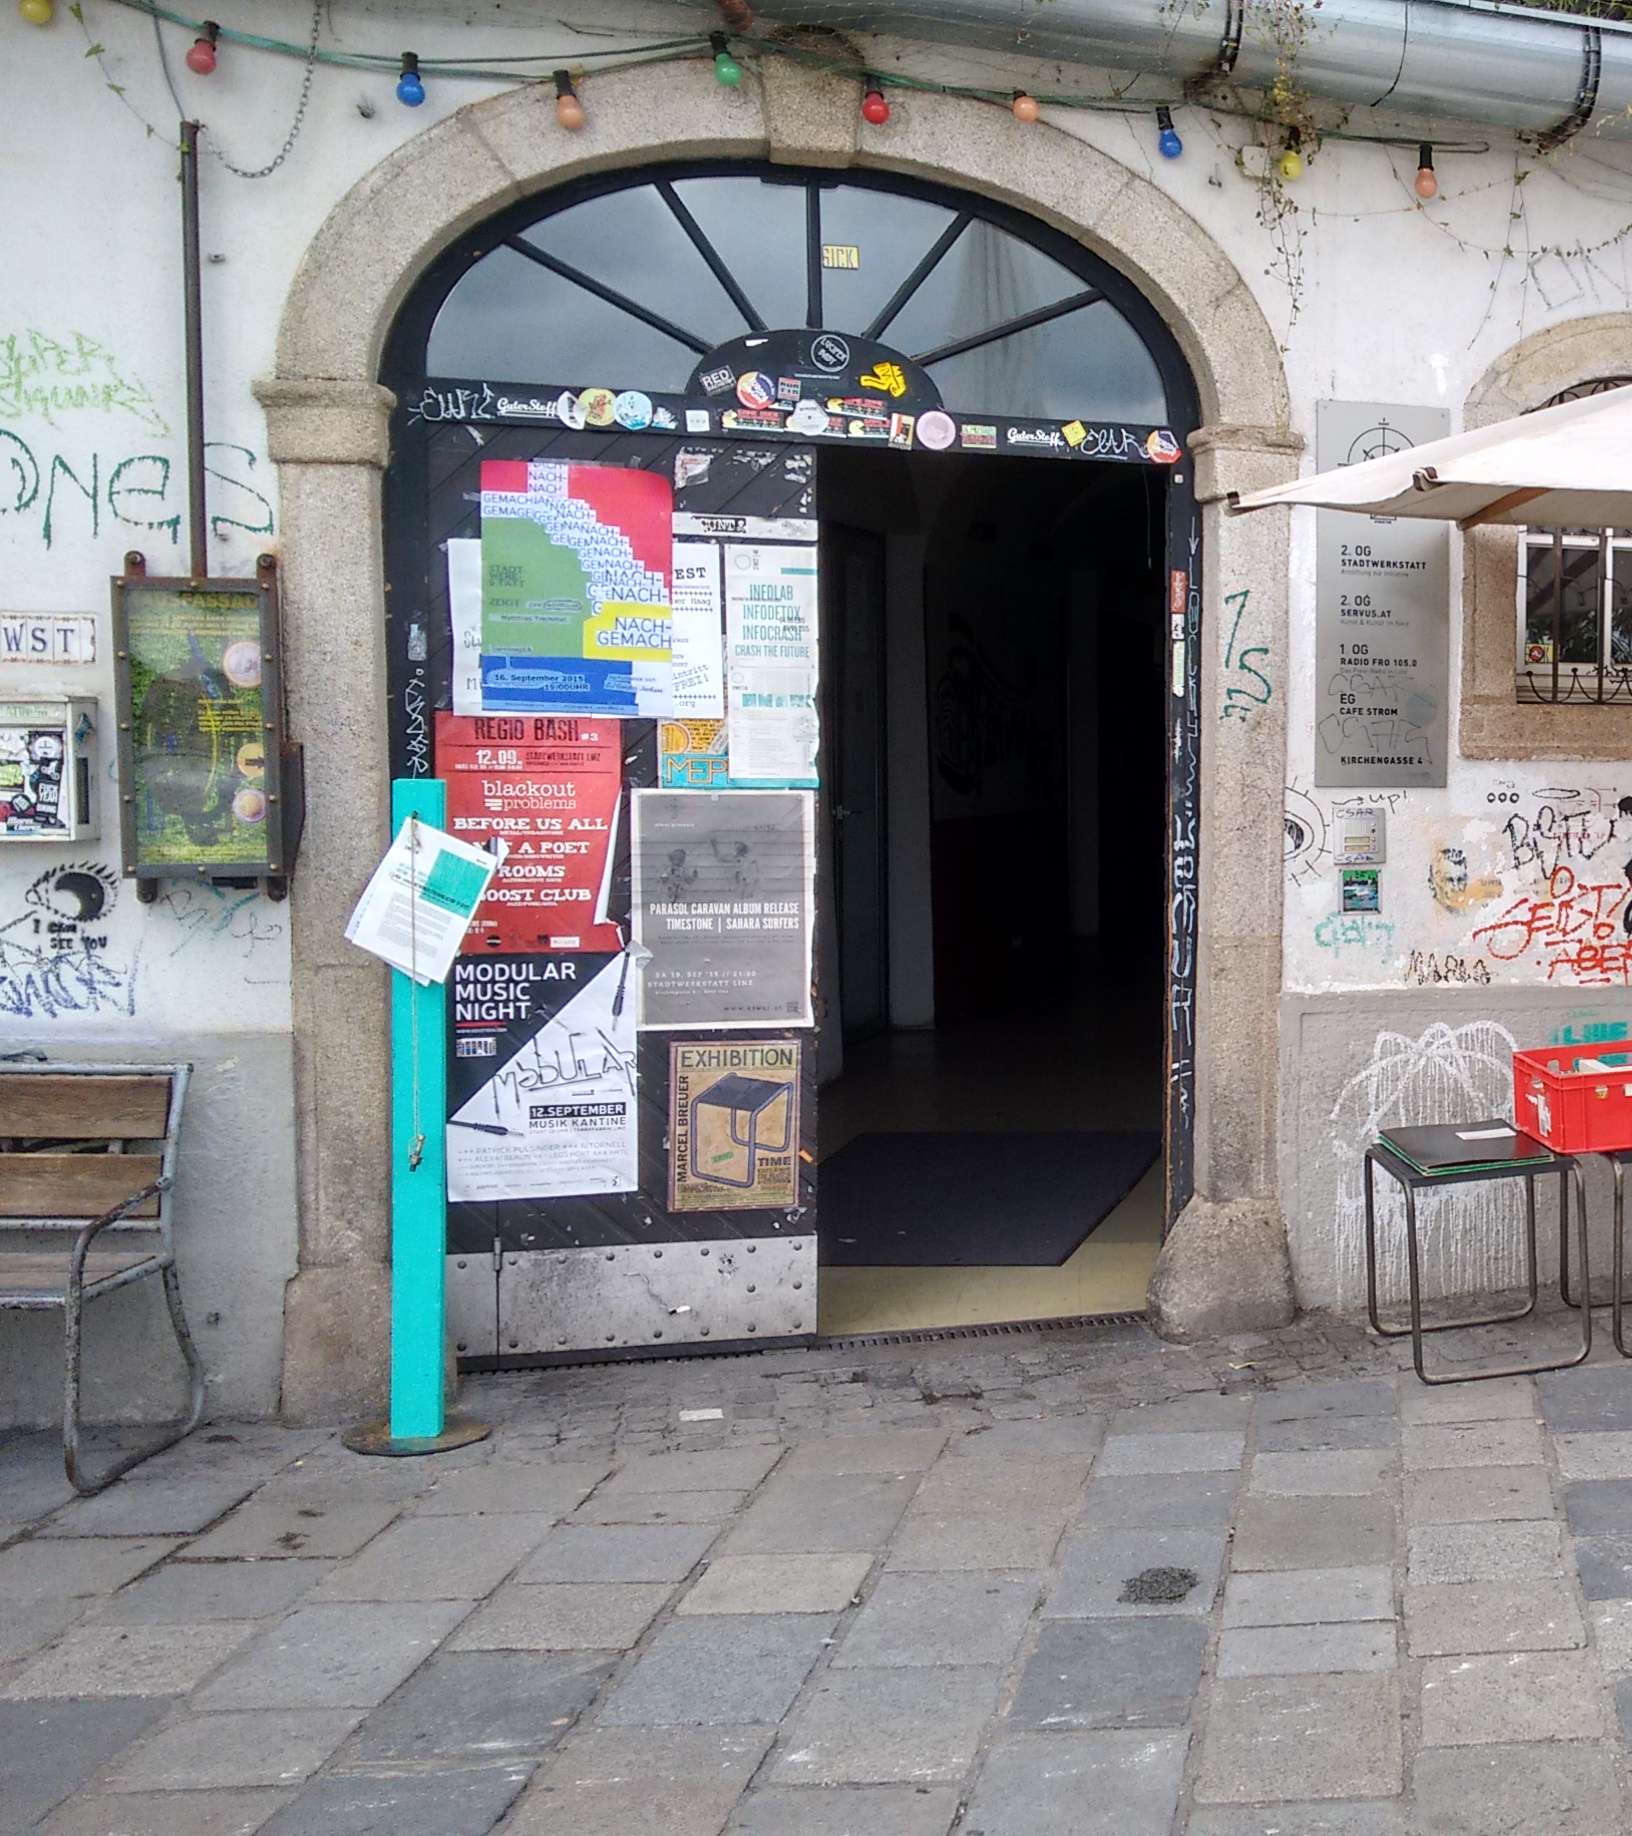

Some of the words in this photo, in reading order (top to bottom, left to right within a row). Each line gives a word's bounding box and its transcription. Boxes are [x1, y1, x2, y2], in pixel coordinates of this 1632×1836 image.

[1355, 545, 1372, 557] OG
[1341, 559, 1426, 570] STADTWERKSTATT
[1354, 595, 1371, 607] OG
[1340, 608, 1392, 618] SERVUS.AT
[614, 616, 672, 633] NACH-
[3, 623, 75, 652] WST
[597, 631, 672, 650] GEMACH
[735, 644, 762, 657] CRASH
[763, 645, 779, 657] THE
[780, 645, 810, 658] FUTURE
[1352, 644, 1369, 655] OG
[1340, 657, 1370, 667] RADIO
[1372, 658, 1390, 667] FRO
[1393, 659, 1418, 668] 105.0
[1340, 694, 1356, 704] EG
[1340, 707, 1364, 716] CAFE
[1366, 708, 1398, 717] STROM
[474, 718, 524, 741] REGIO
[534, 719, 580, 742] BASH
[475, 750, 523, 765] 12.09.
[1340, 756, 1414, 765] KIRCHENGASSE
[482, 780, 576, 797] blackout
[503, 797, 577, 811] problems
[453, 818, 532, 830] BEFORE
[535, 818, 562, 830] US
[567, 818, 608, 830] ALL
[518, 842, 535, 854] A
[540, 842, 590, 854] POET
[540, 889, 592, 901] CLUB
[650, 903, 689, 916] PARASOL
[691, 903, 731, 915] CARAVAN
[732, 903, 762, 915] ALBUM
[763, 902, 799, 914] RELEASE
[666, 918, 714, 931] TIMESTONE
[726, 917, 761, 930] SAHARA
[762, 917, 800, 930] SURFERS
[455, 962, 577, 982] MODULAR
[455, 983, 531, 1001] MUSIC
[455, 1002, 531, 1021] NIGHT
[681, 1048, 793, 1069] EXHIBITION
[677, 1075, 689, 1127] BREUER
[531, 1103, 624, 1118] 12.SEPTEMBER
[529, 1119, 567, 1129] MUSIK
[572, 1117, 626, 1127] KANTINE
[677, 1129, 689, 1183] MARCEL
[757, 1156, 791, 1166] TIME
